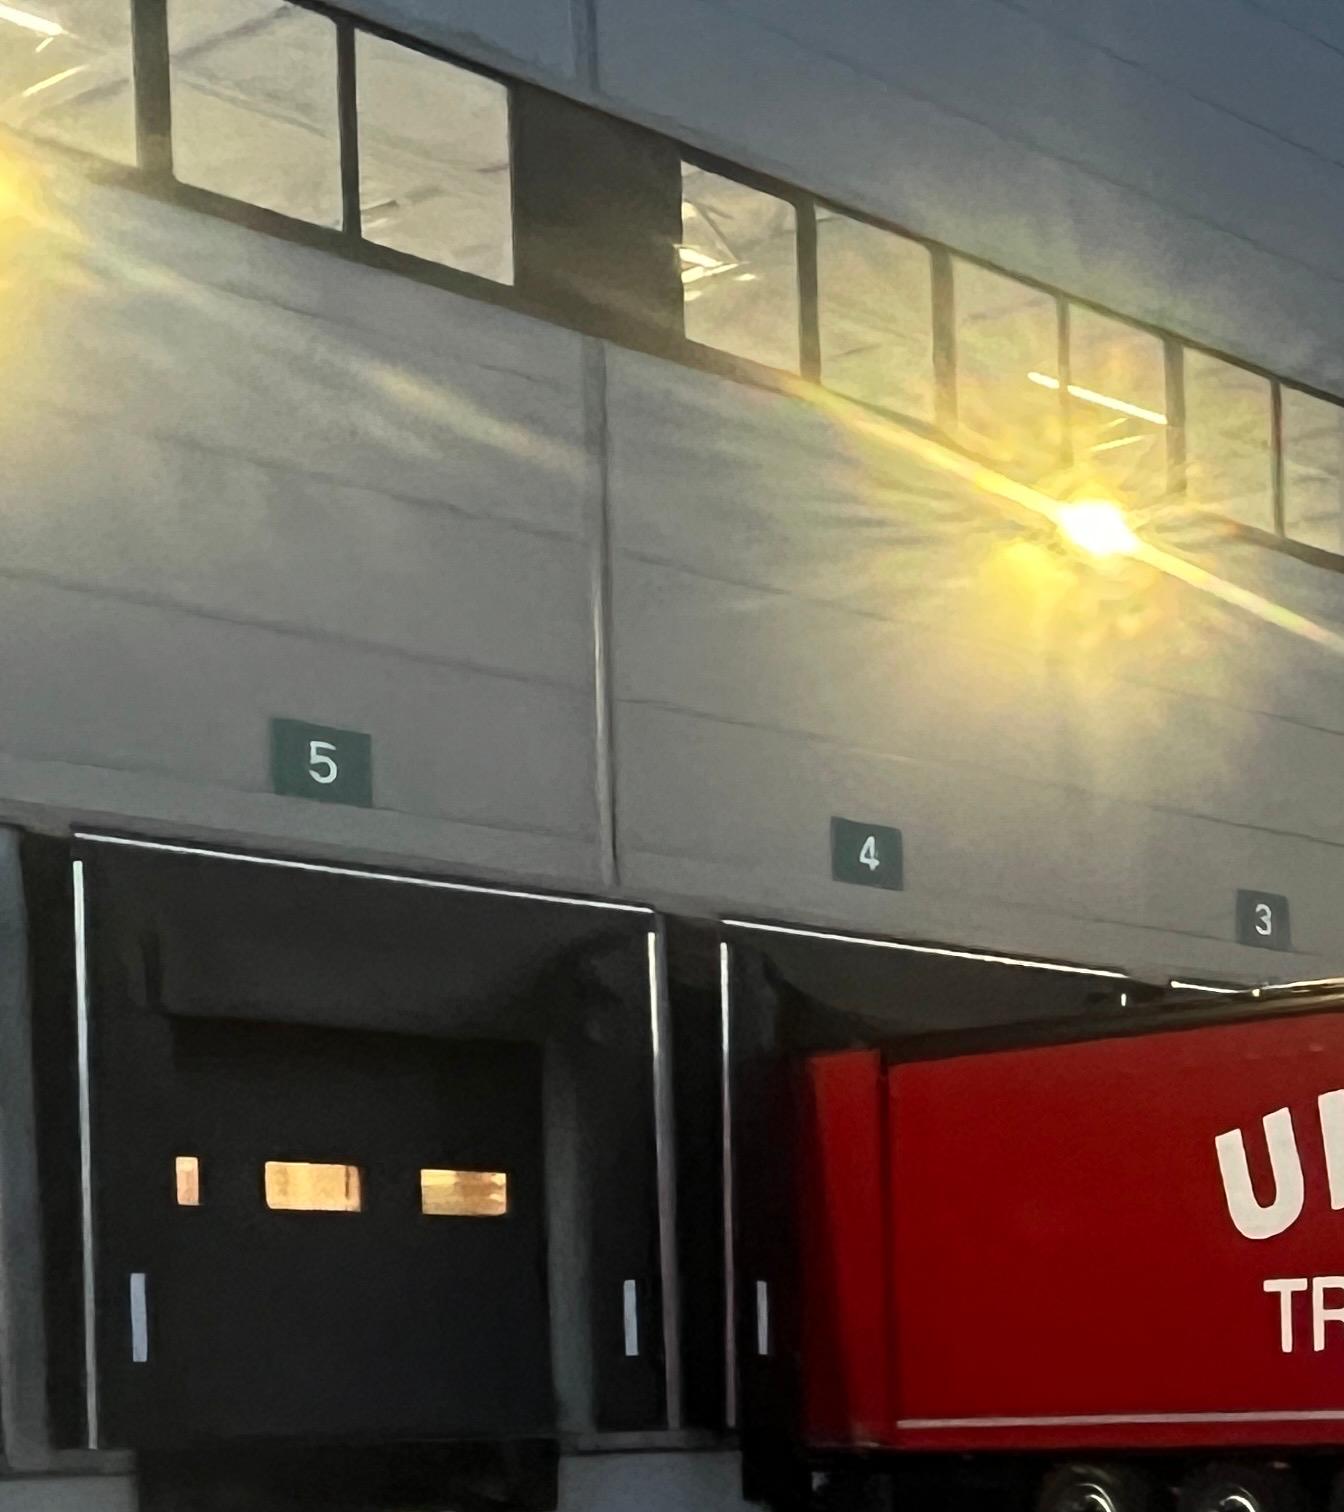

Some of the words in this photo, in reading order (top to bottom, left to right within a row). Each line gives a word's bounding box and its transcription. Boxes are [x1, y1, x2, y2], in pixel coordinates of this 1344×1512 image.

[309, 741, 338, 784] 5
[859, 836, 881, 871] 4
[1255, 903, 1273, 936] 3
